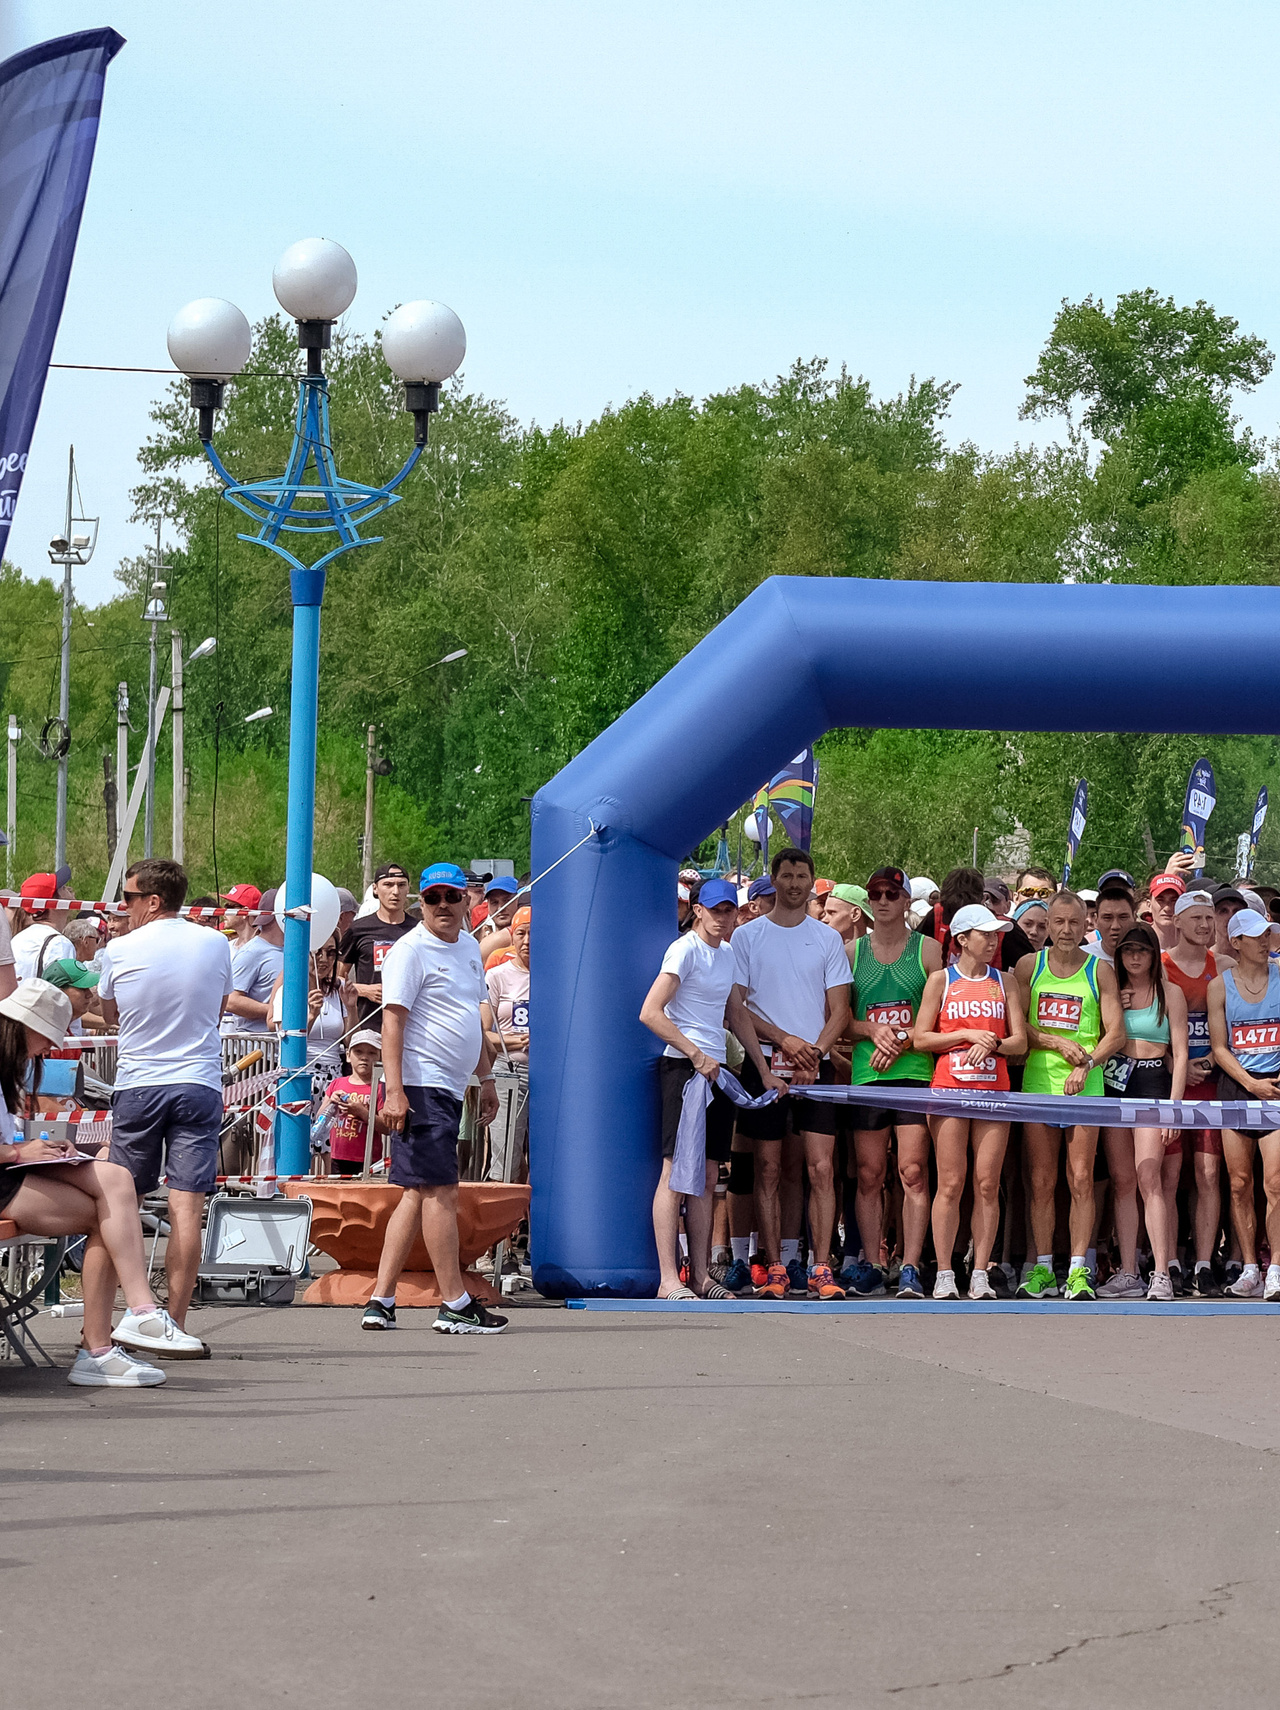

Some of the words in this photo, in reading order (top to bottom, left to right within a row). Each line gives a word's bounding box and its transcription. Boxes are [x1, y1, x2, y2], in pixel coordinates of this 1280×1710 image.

[428, 870, 453, 880] RUSSIA
[1156, 877, 1182, 887] RUSSIA
[868, 1009, 911, 1025] 1420
[947, 1000, 1005, 1020] RUSSIA
[1038, 1002, 1081, 1023] 1412
[1234, 1027, 1279, 1046] 1477
[1103, 1058, 1129, 1082] 24
[1136, 1059, 1163, 1069] PRO
